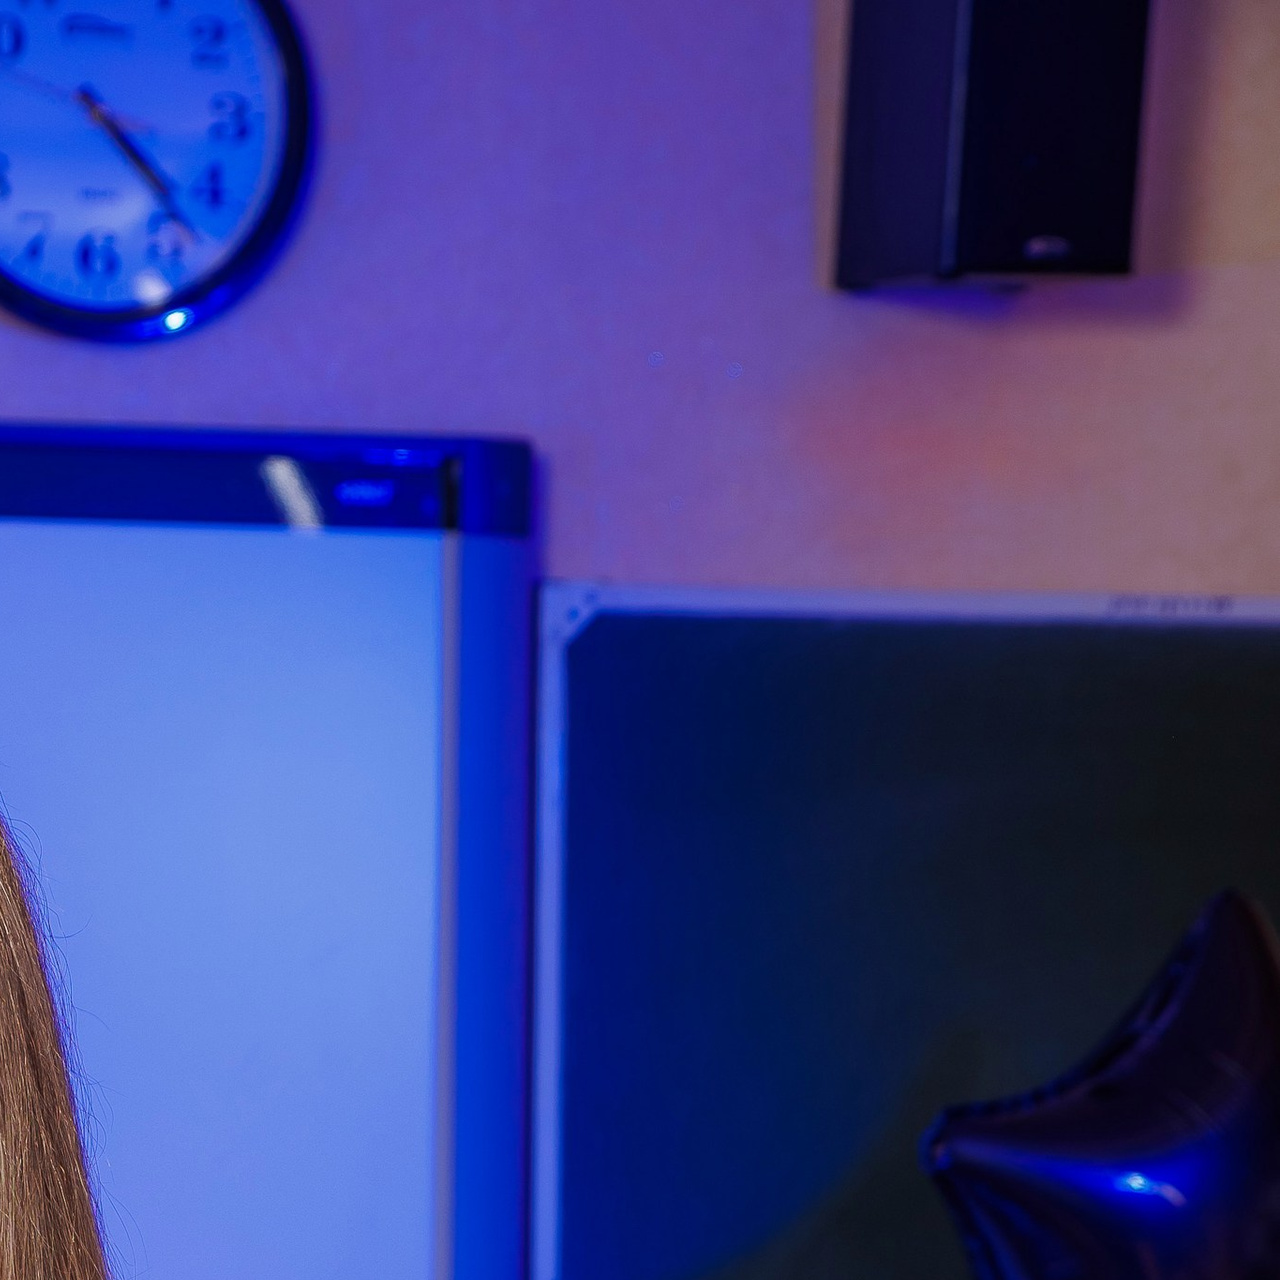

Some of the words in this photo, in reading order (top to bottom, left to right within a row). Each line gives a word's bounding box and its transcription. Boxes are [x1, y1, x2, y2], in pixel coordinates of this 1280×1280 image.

[188, 14, 230, 70] 2
[208, 91, 252, 145] 3
[191, 162, 228, 211] 4
[17, 210, 54, 266] 7
[74, 232, 121, 280] 6
